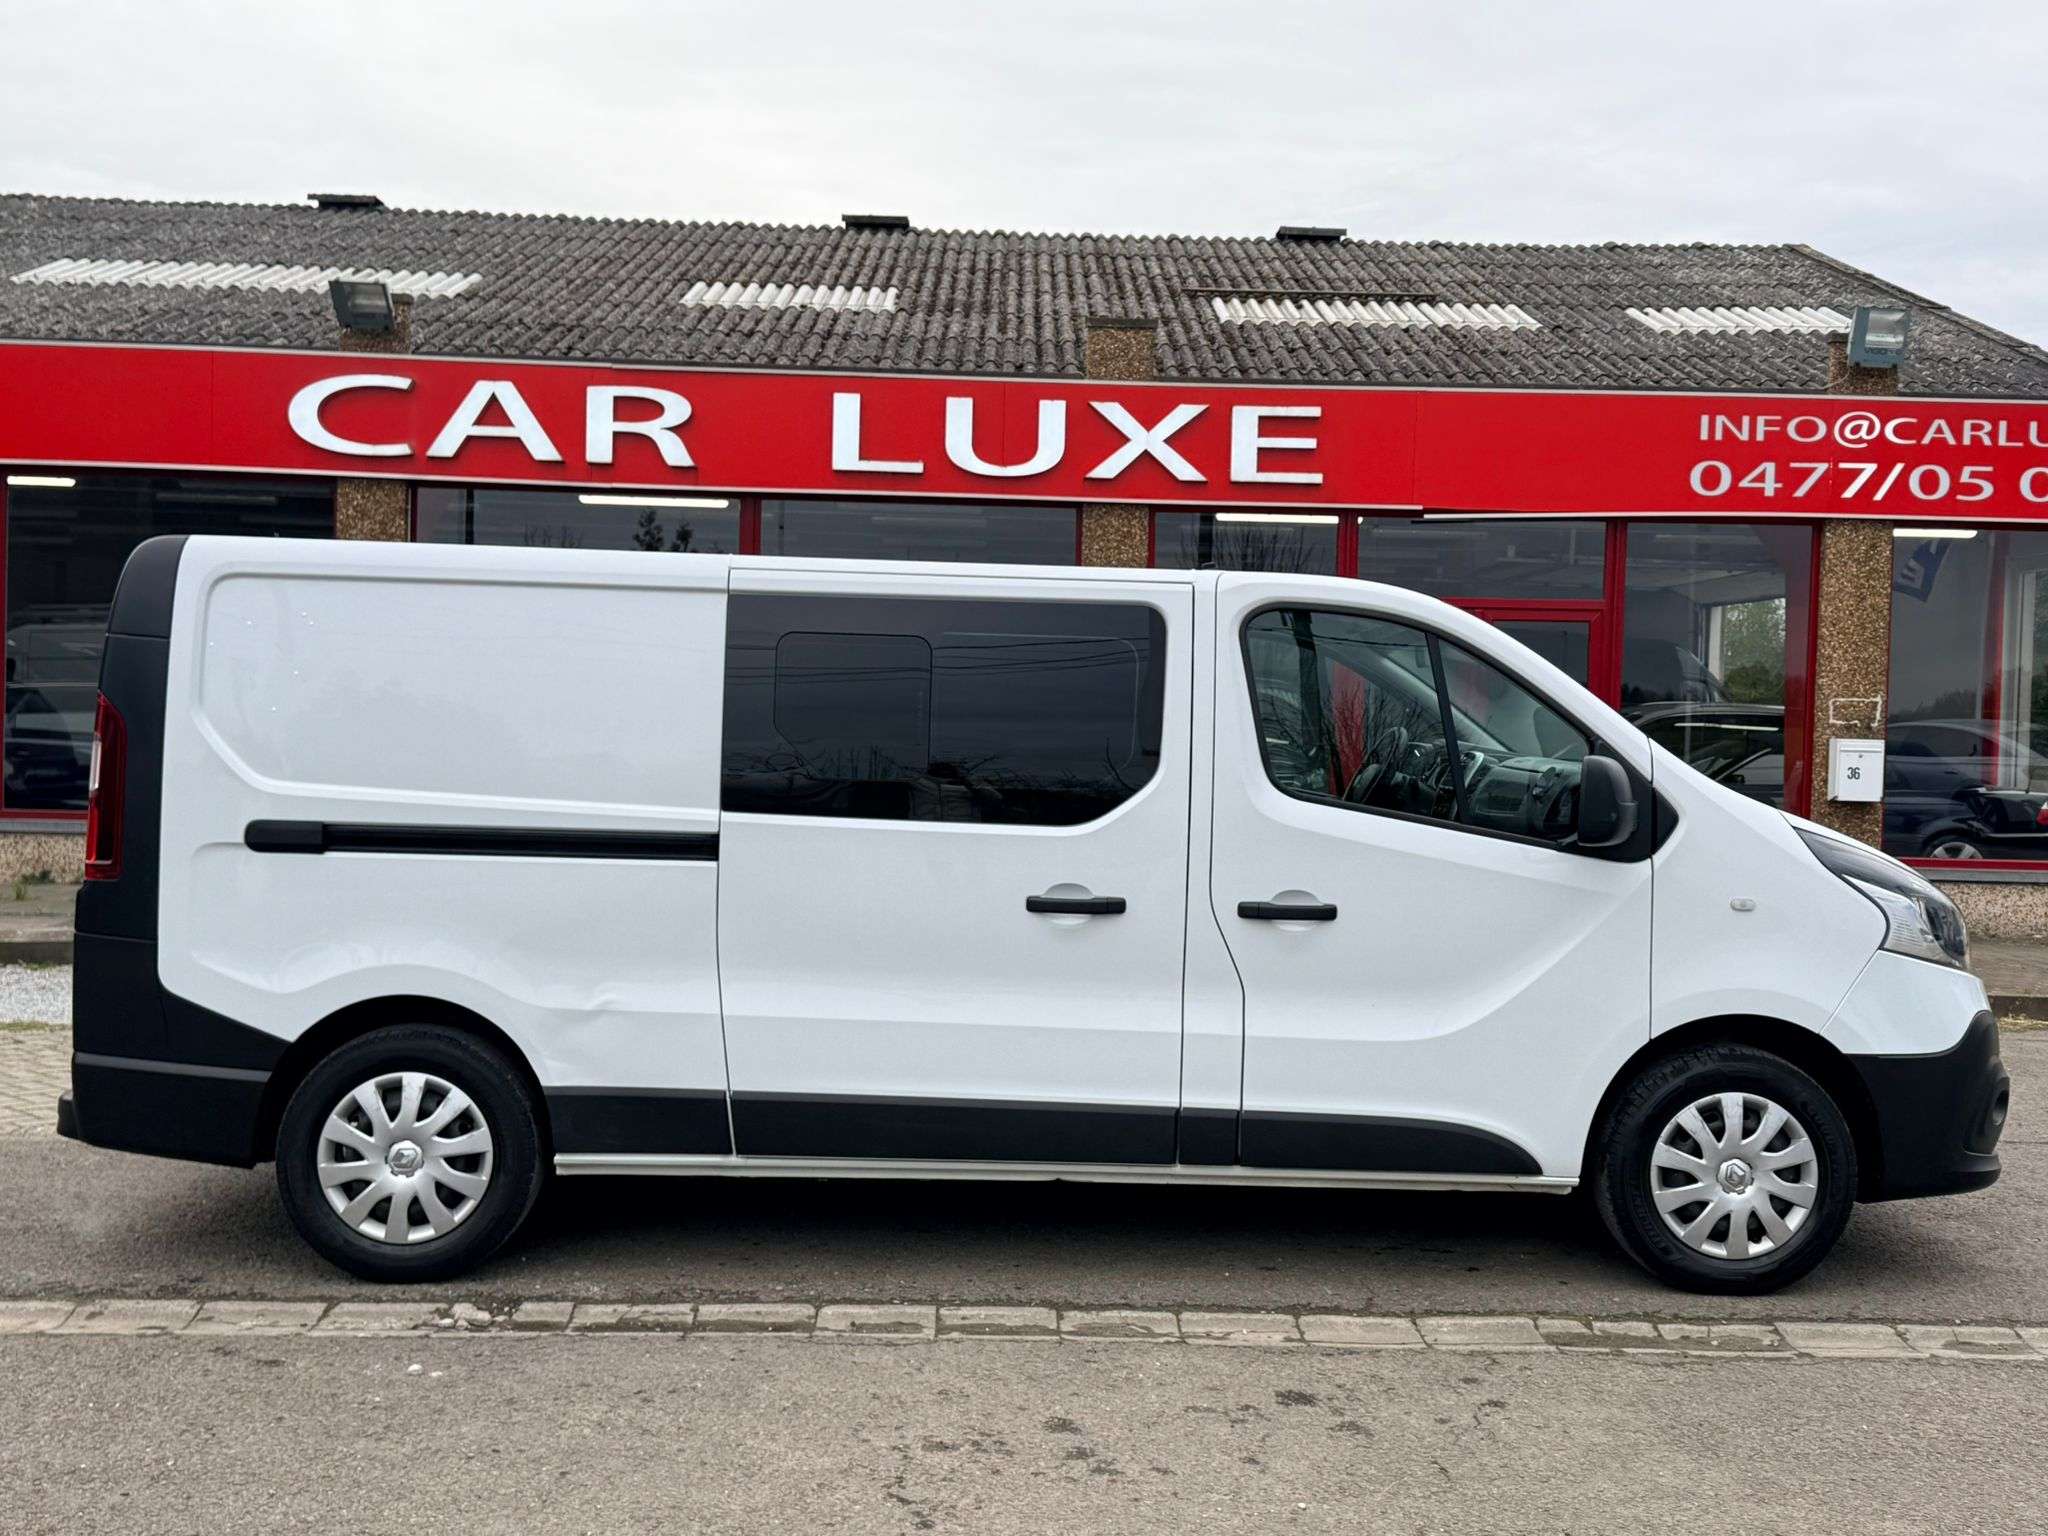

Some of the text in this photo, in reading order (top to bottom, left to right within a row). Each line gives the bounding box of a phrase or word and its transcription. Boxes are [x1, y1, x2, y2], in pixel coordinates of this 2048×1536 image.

[288, 374, 1324, 485] CAR LUXE
[1689, 460, 1995, 502] 0477/05
[1847, 766, 1861, 780] 36
